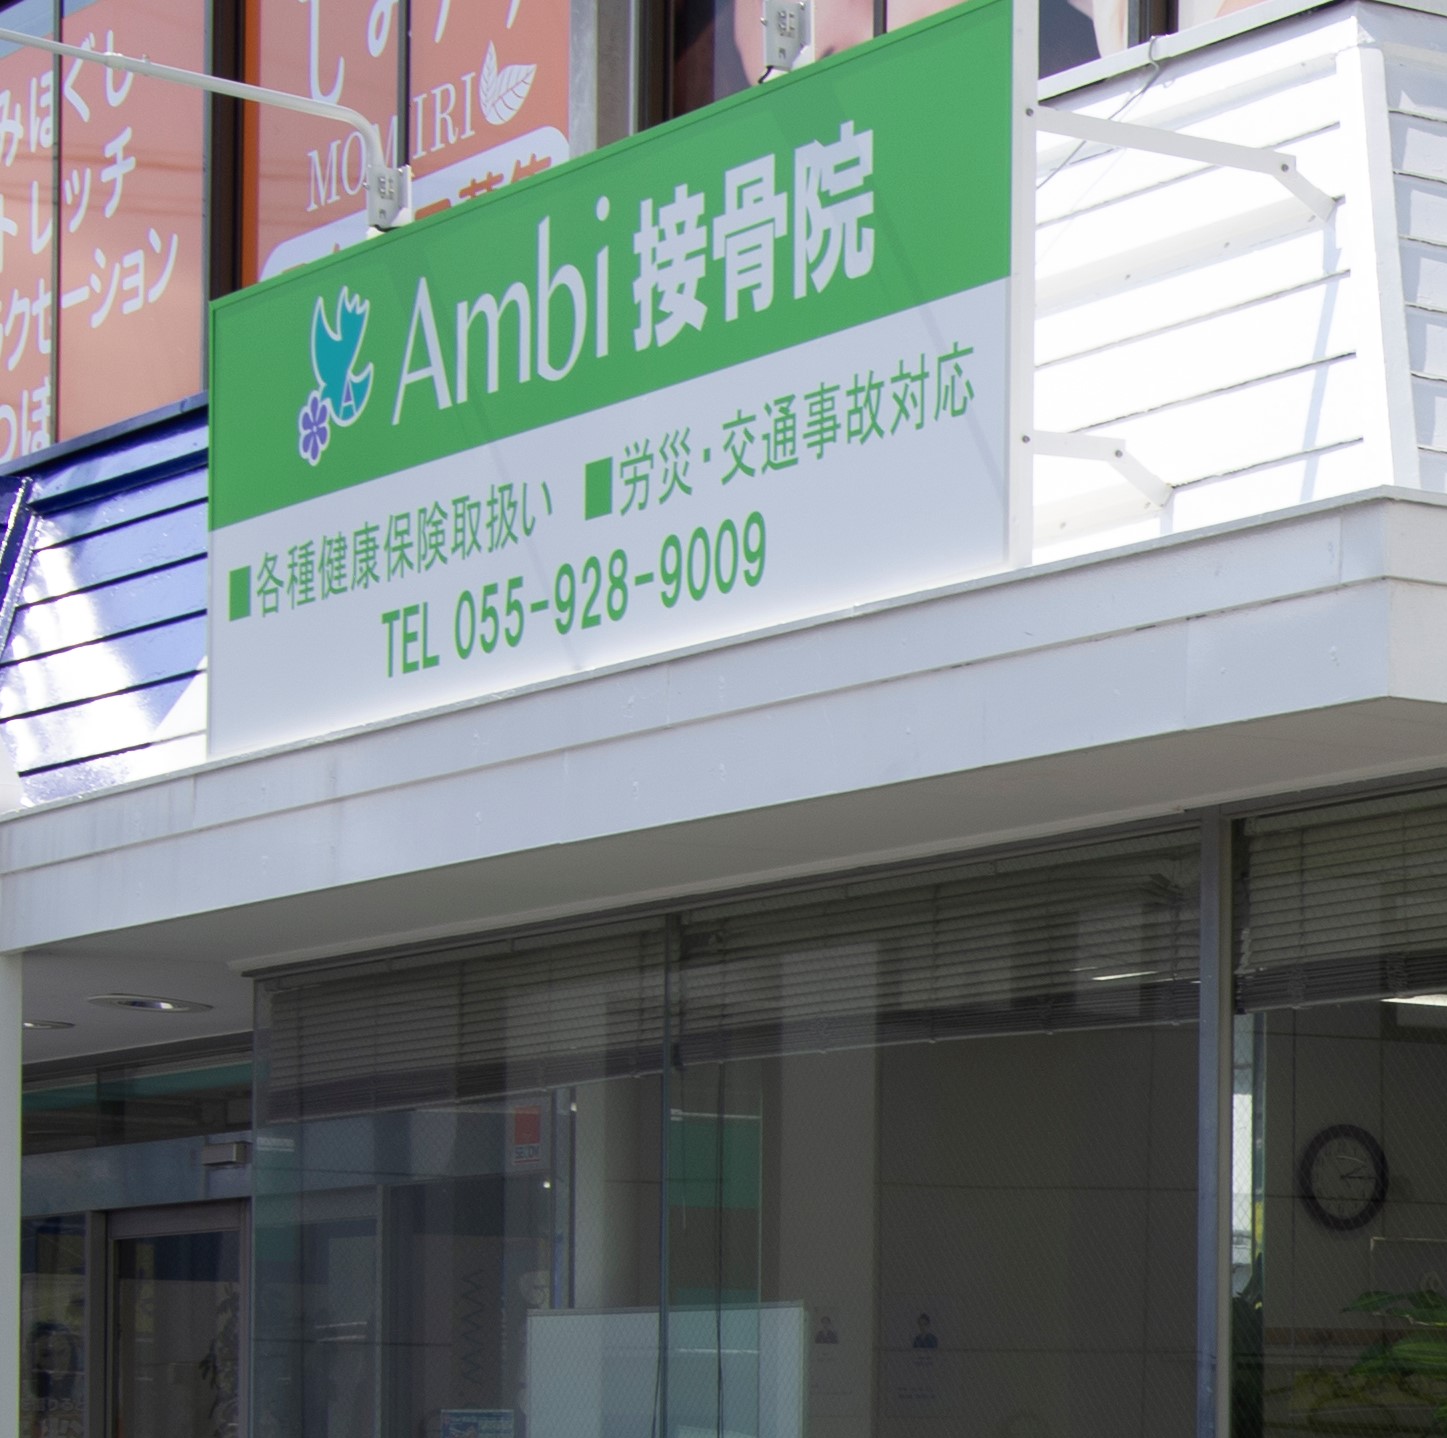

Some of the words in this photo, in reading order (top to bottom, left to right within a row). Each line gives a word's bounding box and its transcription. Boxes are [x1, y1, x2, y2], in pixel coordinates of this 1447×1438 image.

[391, 197, 609, 426] Ambi
[632, 120, 876, 352] 接骨院
[256, 481, 553, 619] 各種健康保険取扱い
[617, 340, 977, 518] 労災・交通事故対応
[381, 607, 440, 679] TEL
[454, 510, 767, 660] 055-928-9009
